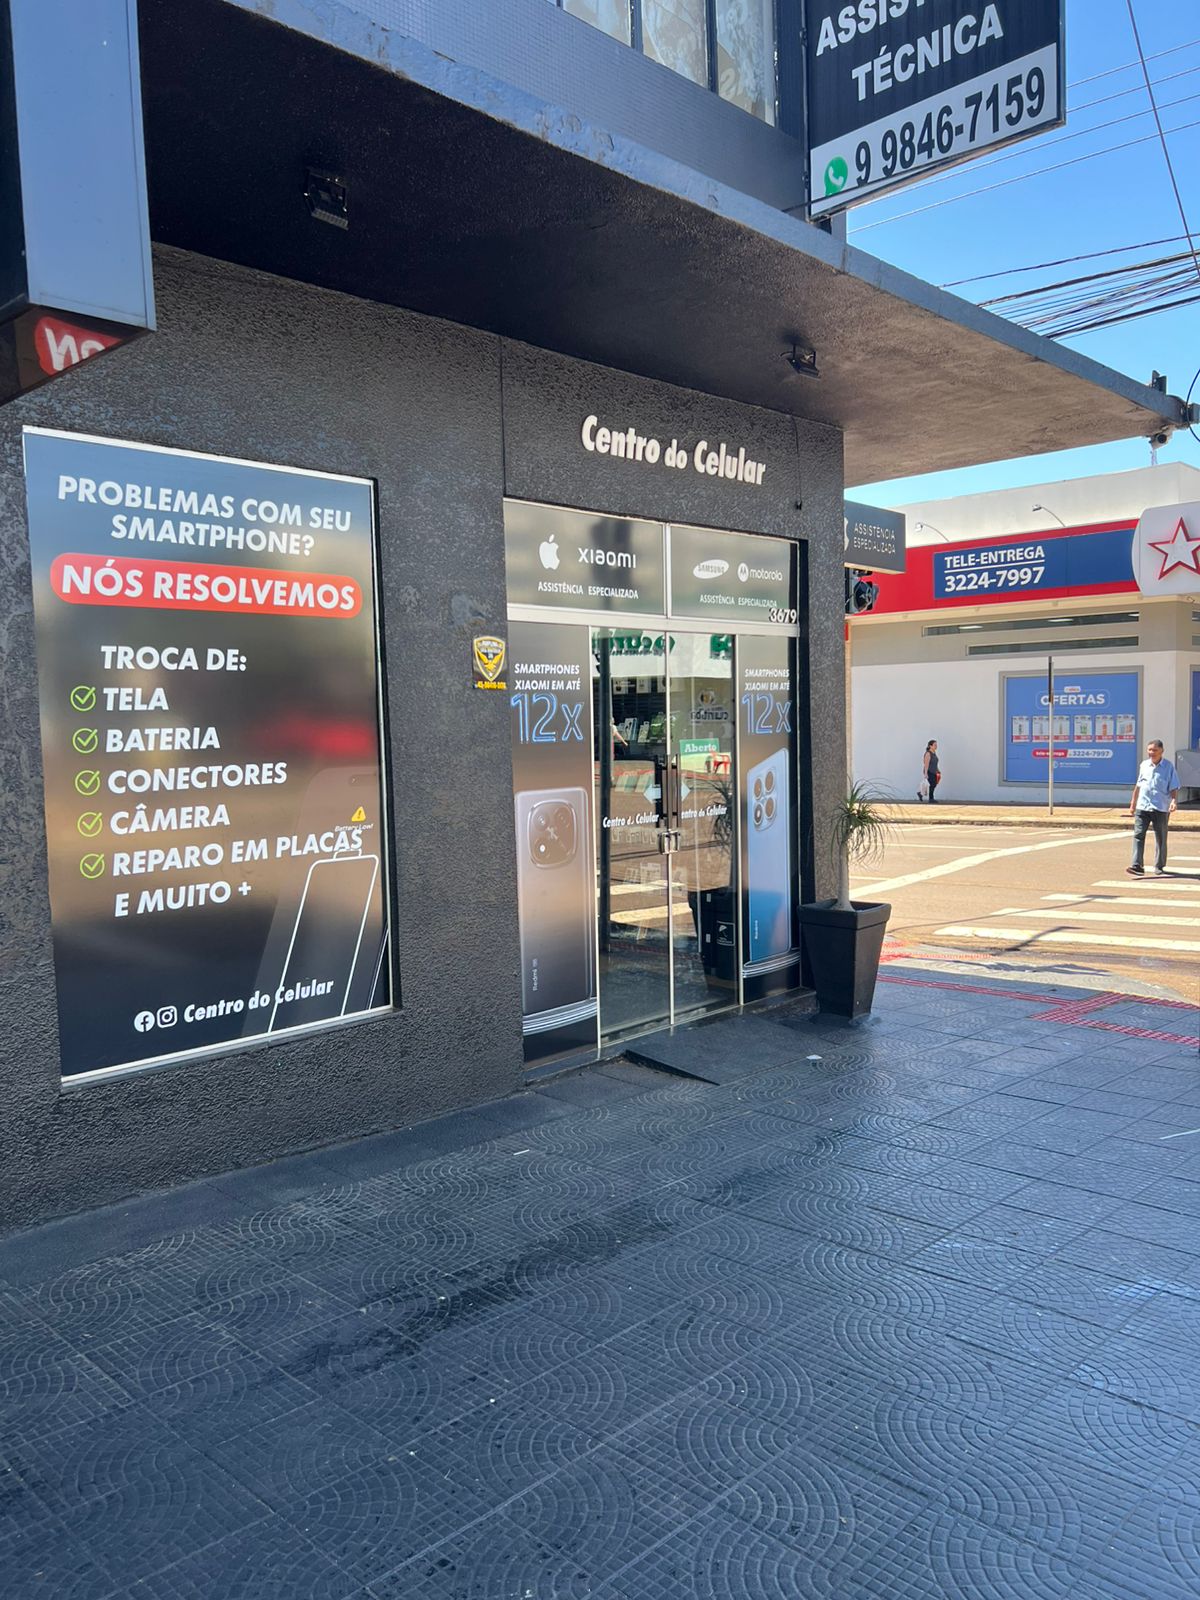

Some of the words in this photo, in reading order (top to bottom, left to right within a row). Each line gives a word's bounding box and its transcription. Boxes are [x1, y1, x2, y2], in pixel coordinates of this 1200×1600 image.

[851, 3, 1004, 102] TÉCNICA
[855, 140, 872, 188] 9
[881, 66, 1045, 179] 9846-7159
[581, 415, 661, 464] Centro
[664, 439, 688, 469] do
[694, 440, 766, 485] Celular
[58, 475, 235, 519] PROBLEMAS
[241, 499, 302, 526] COM
[309, 507, 351, 532] SEU
[111, 514, 315, 557] SMARTPHONE?
[853, 536, 896, 554] ESPECIALIZADA
[944, 545, 1046, 569] TELE-ENTREGA
[61, 559, 143, 598] NÓS
[153, 572, 355, 611] RESOLVEMOS
[749, 568, 783, 581] motorola
[944, 566, 1046, 592] 3224-7997
[538, 581, 584, 595] ASSISTÊNCIA
[588, 585, 639, 599] ESPECIALIZADA
[700, 594, 735, 606] ASSISTÊNCIA
[738, 597, 778, 608] ESPECIALIZADA
[769, 607, 797, 623] 3679
[101, 646, 199, 671] TROCA
[206, 649, 247, 671] DE:
[514, 663, 580, 675] SMARTPHONES
[515, 679, 549, 690] XIAOMI
[551, 680, 564, 690] EM
[566, 677, 581, 690] ATÉ
[745, 668, 790, 678] SMARTPHONES
[745, 682, 768, 691] XIAOMI
[770, 682, 779, 691] EM
[780, 680, 790, 691] ATÉ
[103, 687, 169, 711] TELA
[105, 727, 220, 753] BATERIA
[684, 743, 717, 753] Aberto
[107, 762, 287, 794] CONECTORES
[110, 803, 231, 835] CÂMERA
[602, 816, 626, 828] Centro
[635, 811, 659, 824] Celular
[112, 843, 224, 877] REPARO
[231, 839, 268, 864] EM
[275, 829, 363, 858] PLACAS
[115, 893, 130, 918] E
[136, 881, 232, 915] MUITO
[184, 998, 244, 1023] Centro
[248, 990, 269, 1009] do
[275, 978, 334, 1005] Celular
